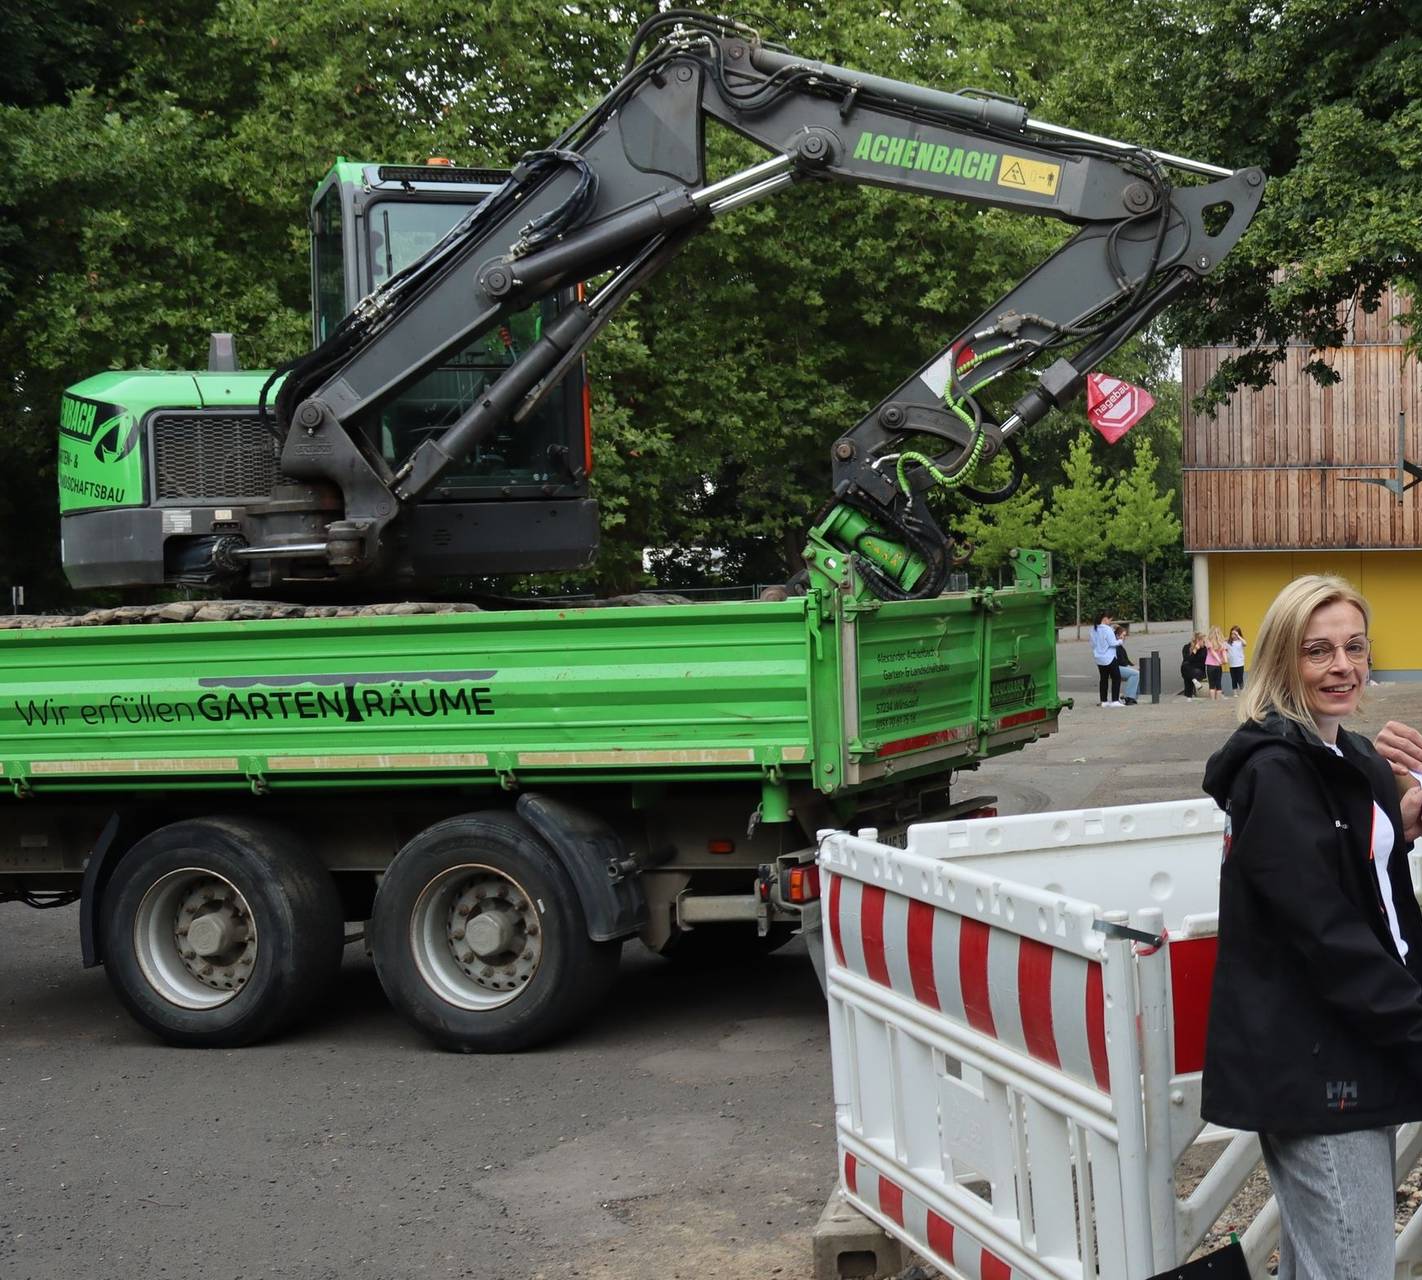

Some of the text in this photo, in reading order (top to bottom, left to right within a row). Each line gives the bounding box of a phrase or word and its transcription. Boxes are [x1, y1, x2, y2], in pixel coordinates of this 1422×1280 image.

[853, 131, 997, 182] ACHENBACH
[1093, 383, 1130, 416] hagebau
[15, 698, 69, 726] Wir
[80, 694, 194, 725] erfüllen
